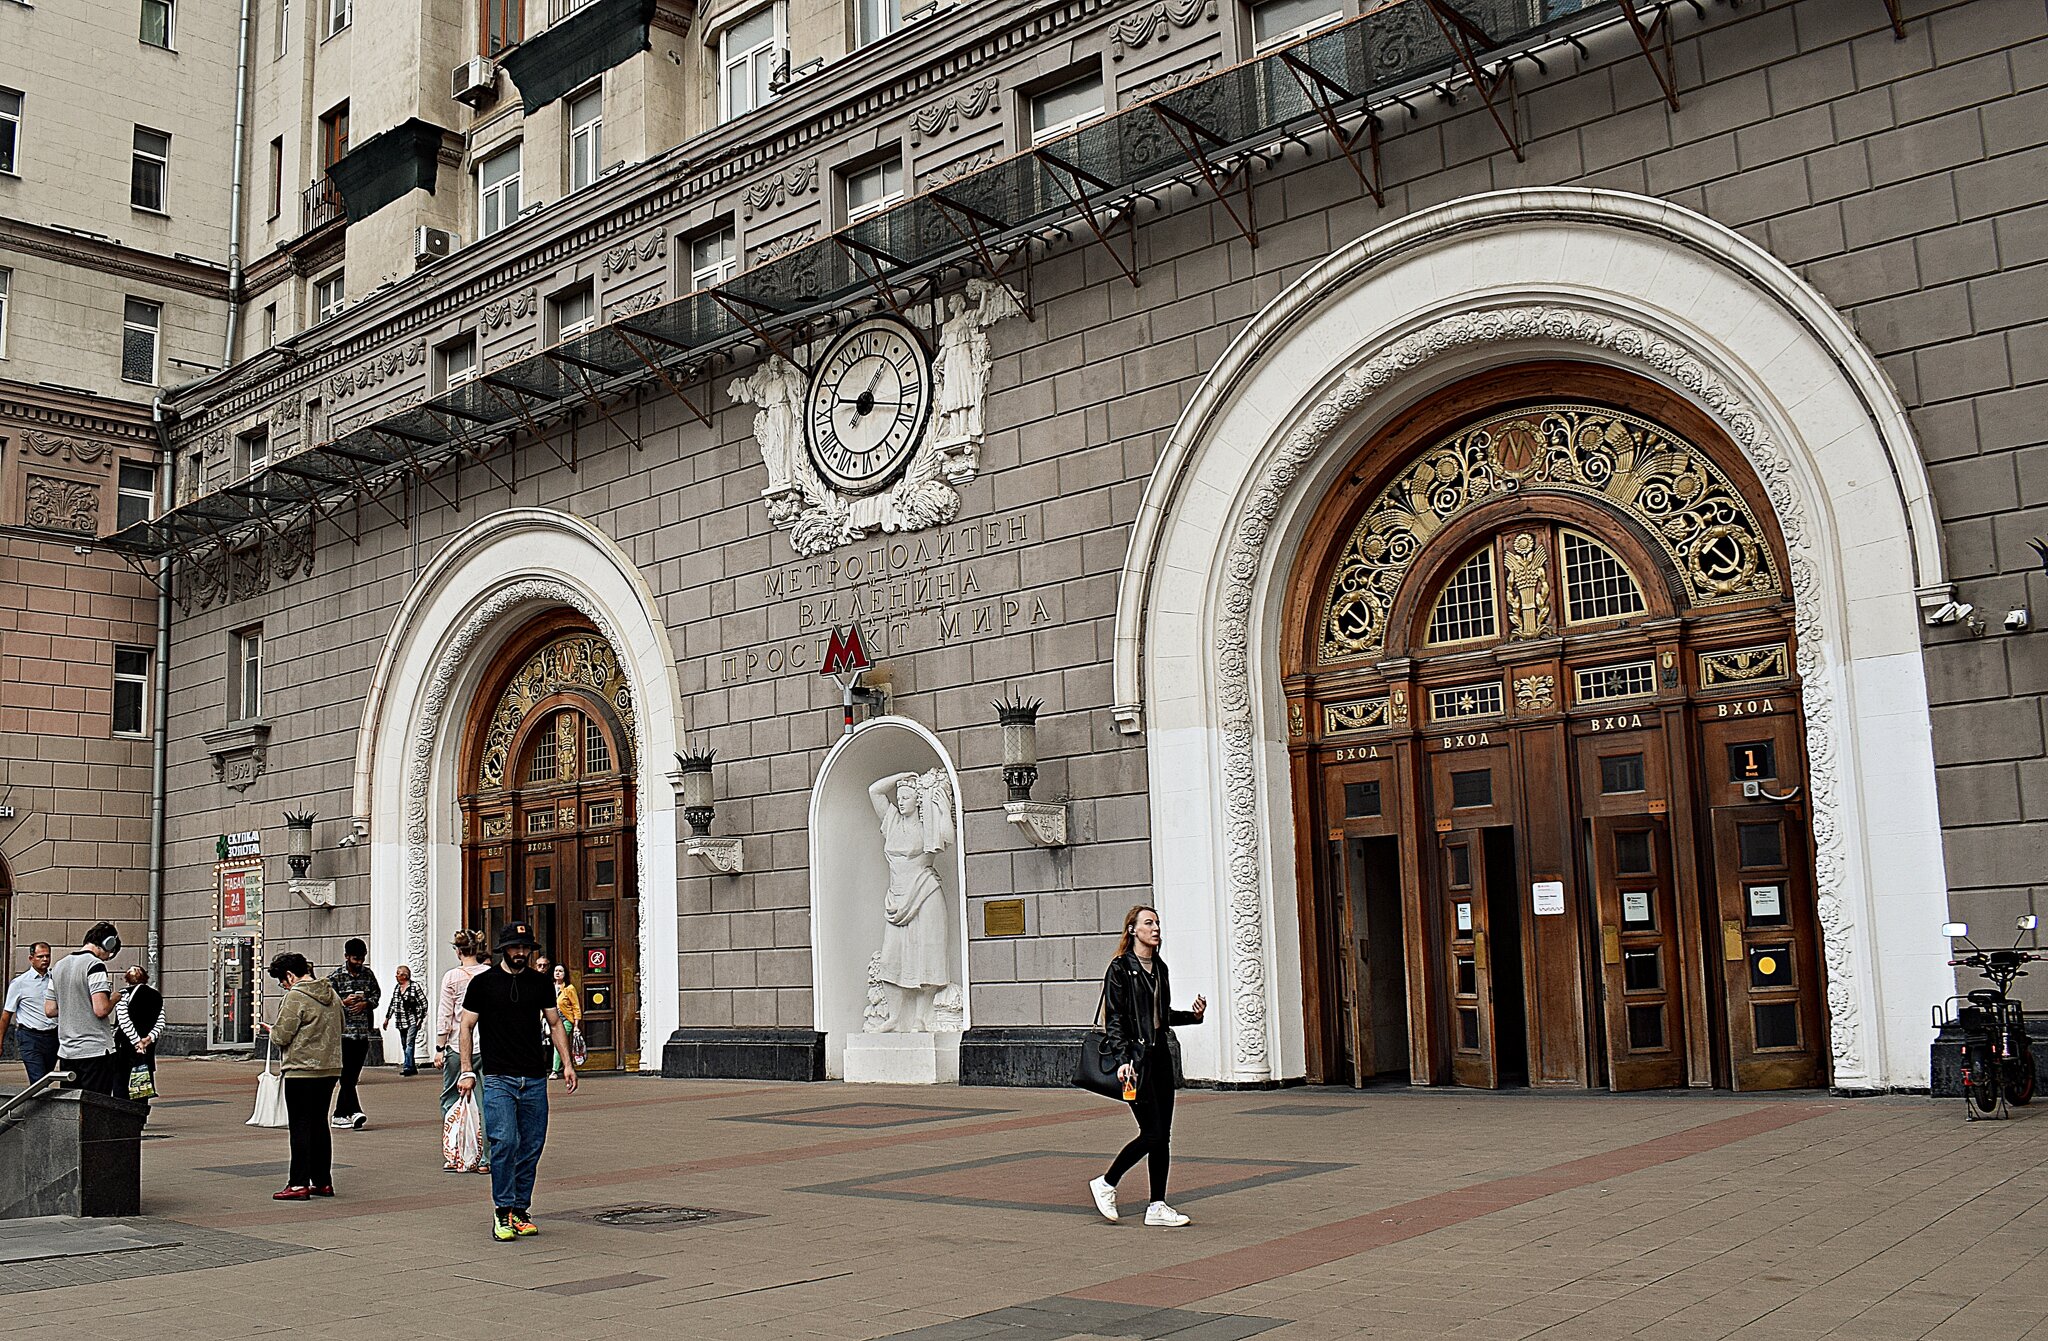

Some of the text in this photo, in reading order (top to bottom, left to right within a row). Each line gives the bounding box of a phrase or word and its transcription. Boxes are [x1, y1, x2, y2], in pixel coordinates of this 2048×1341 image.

[764, 514, 1028, 599] МЕТРОПОЛИТЕН
[848, 566, 981, 619] ЛЕНИНА
[721, 596, 1052, 682] ПРОСПКТ МИРА
[819, 620, 874, 677] М
[1718, 698, 1774, 717] ВХОД
[1591, 714, 1642, 732] ВХОД
[1443, 732, 1490, 749] ВХОД
[1336, 746, 1379, 761] ВХОД
[1744, 750, 1759, 770] 1
[227, 830, 260, 845] СКУПКА
[227, 843, 261, 858] ЗОЛОТА
[230, 892, 240, 907] 24
